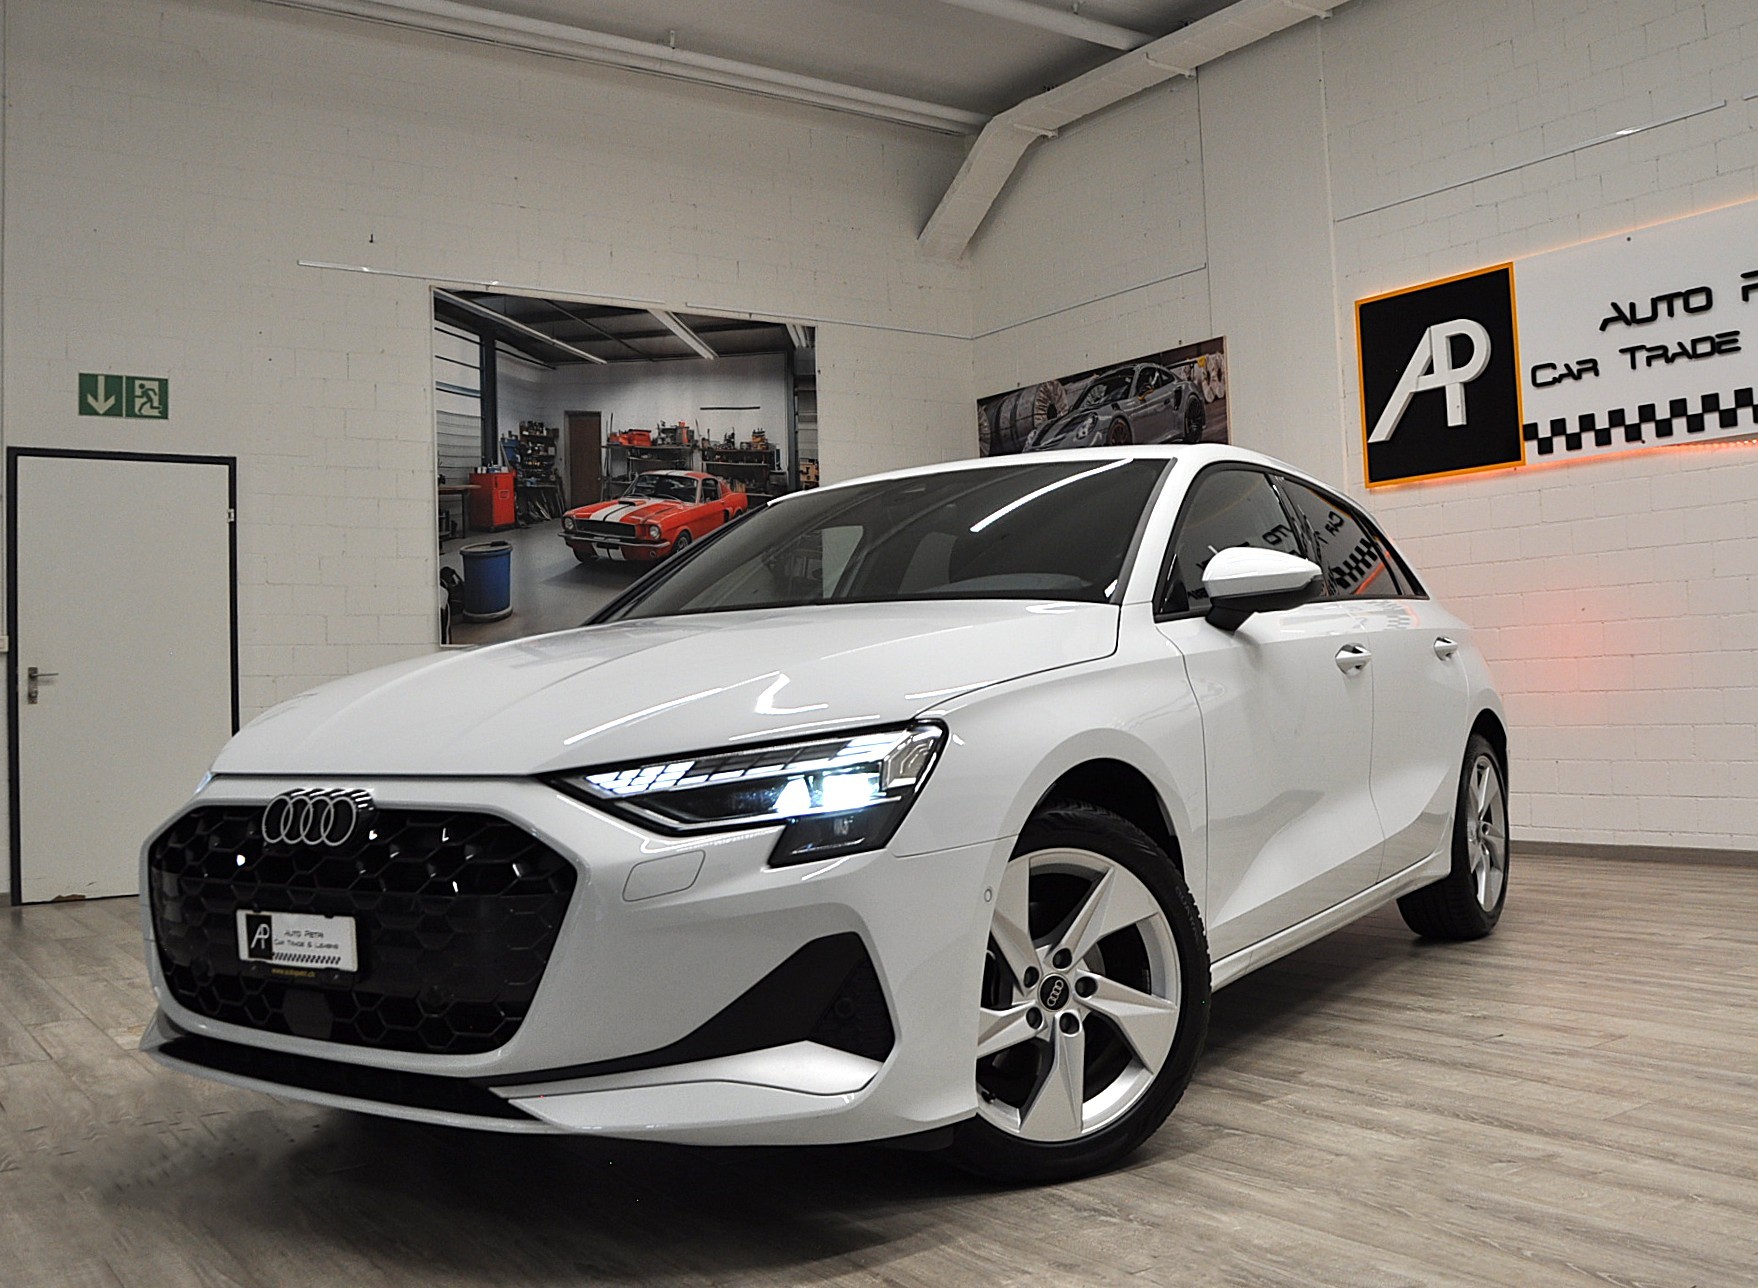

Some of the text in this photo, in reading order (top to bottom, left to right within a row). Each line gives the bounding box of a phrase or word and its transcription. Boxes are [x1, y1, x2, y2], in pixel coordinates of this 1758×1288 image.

[1599, 286, 1713, 331] AUTO
[1369, 318, 1492, 443] AP
[1531, 330, 1742, 388] CAR TRADE
